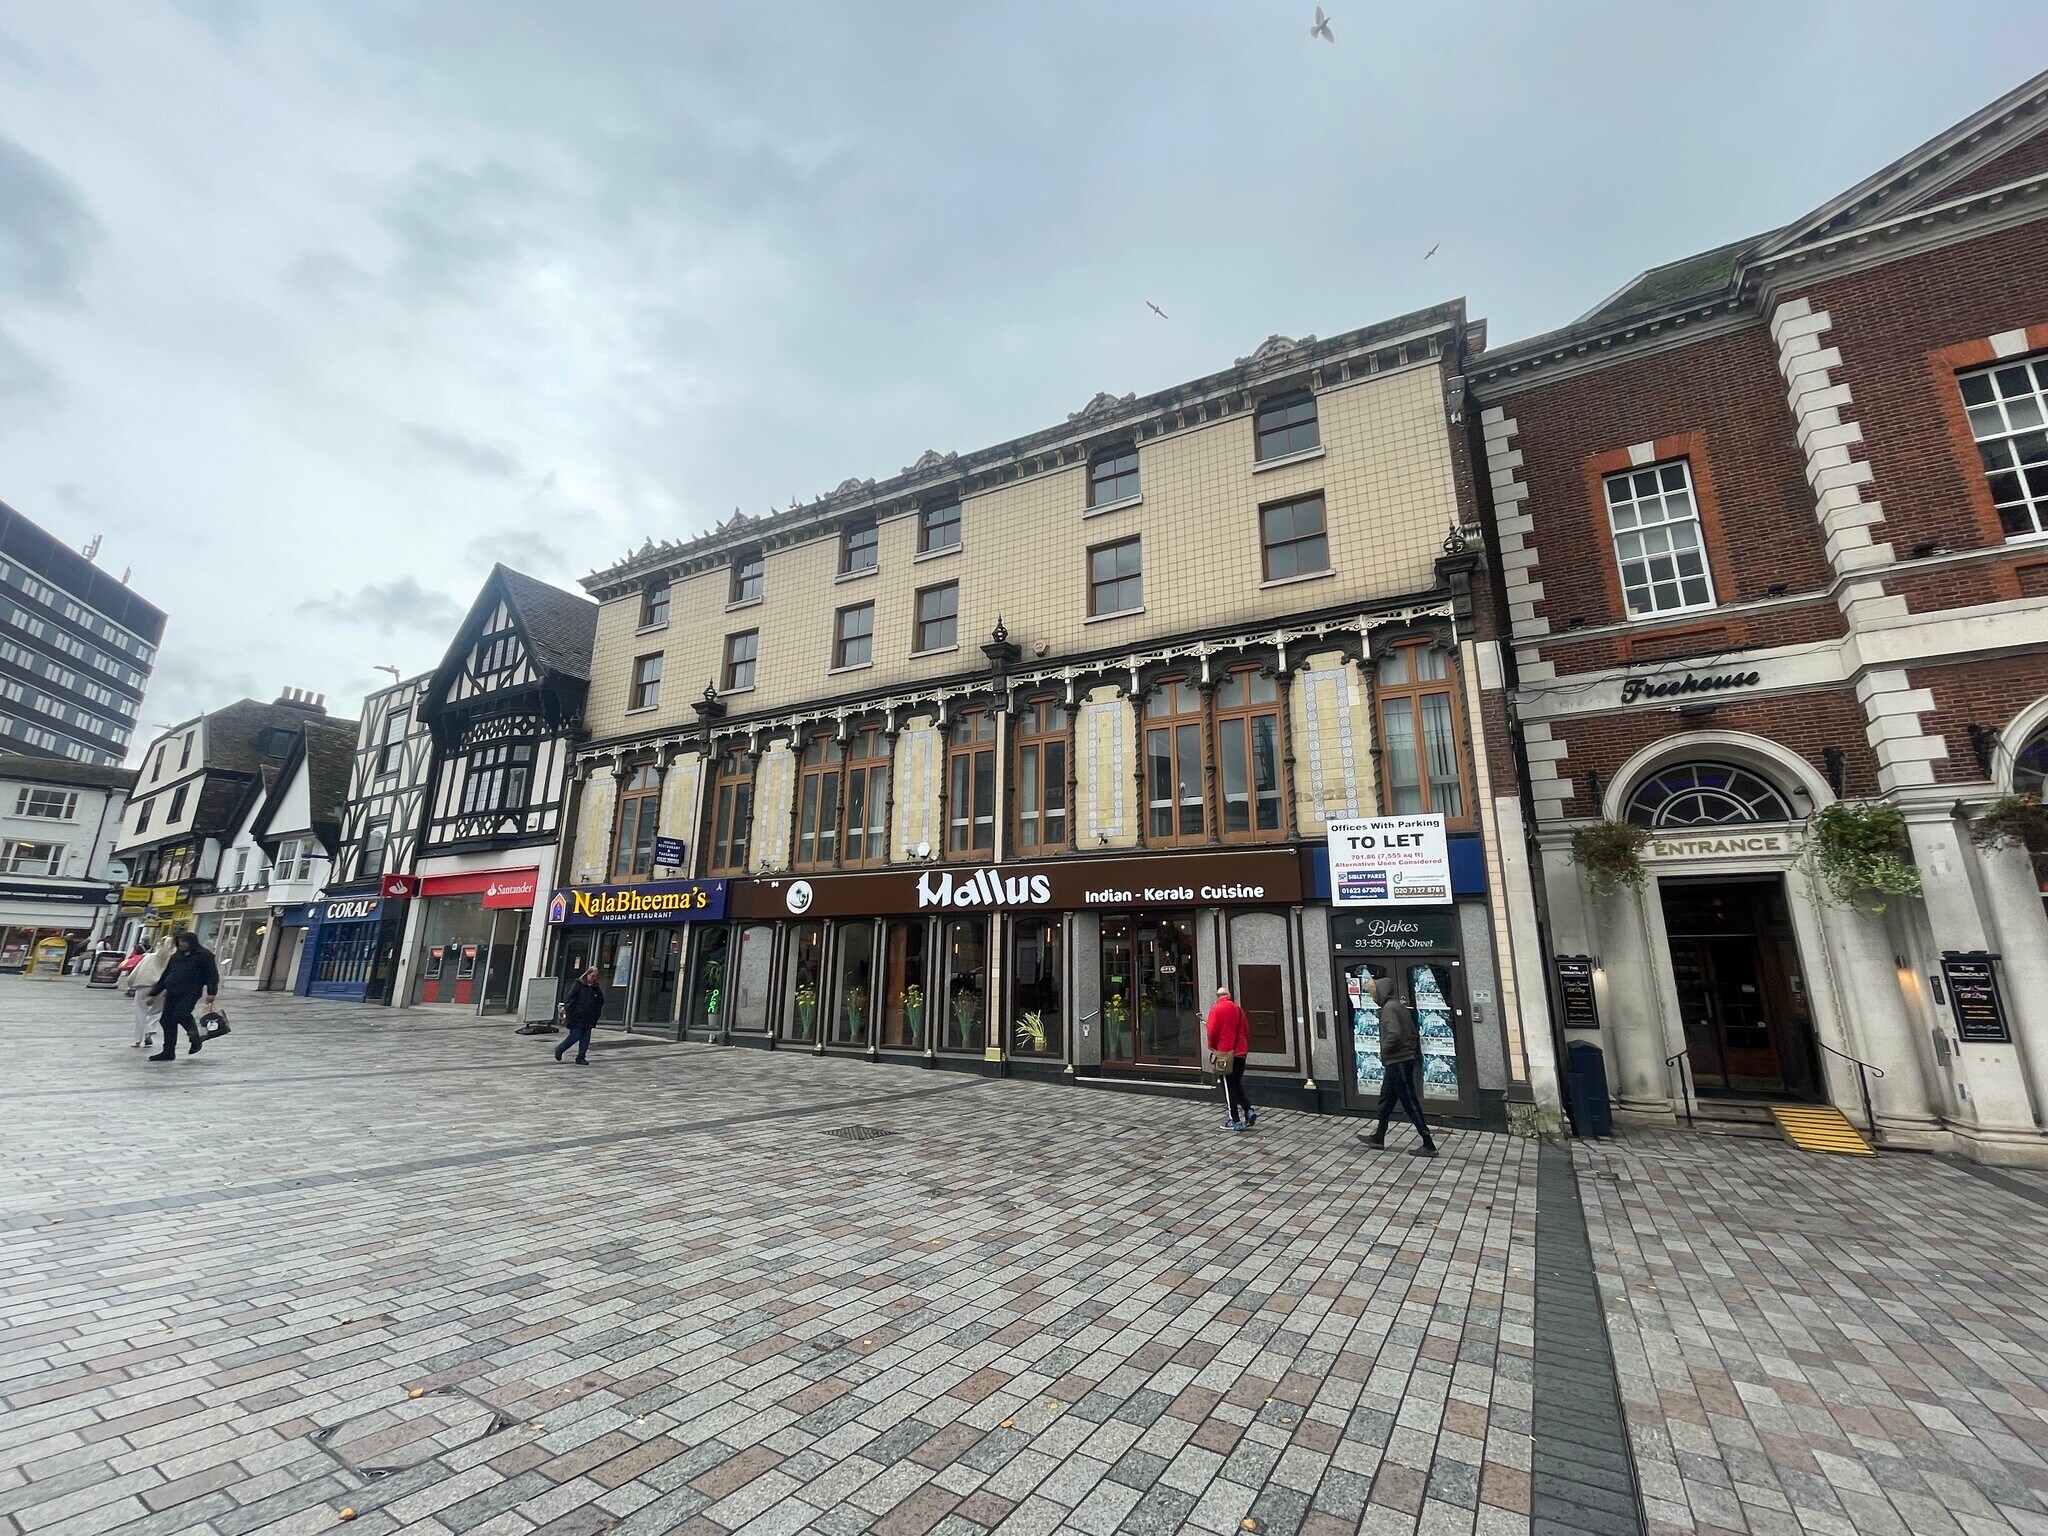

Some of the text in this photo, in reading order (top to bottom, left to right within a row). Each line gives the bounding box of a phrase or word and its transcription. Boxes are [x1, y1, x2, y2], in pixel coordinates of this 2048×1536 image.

[1621, 671, 1760, 704] Freehouse
[1331, 820, 1440, 832] Offices With Parking
[1347, 833, 1424, 849] TO LET
[1655, 837, 1779, 857] ENTRANCE
[1414, 851, 1424, 859] ft)
[496, 881, 533, 897] Santander
[916, 868, 1051, 908] Mallus
[1085, 888, 1133, 903] Indian
[1144, 886, 1194, 901] Kerala
[1200, 883, 1265, 899] Cuisine
[327, 901, 368, 919] CORAL
[571, 887, 706, 917] NalaBheema's
[602, 911, 673, 921] INDIAN RESTAURANT
[1367, 920, 1419, 937] Blakes
[1382, 939, 1407, 950] High
[1407, 939, 1434, 948] Street
